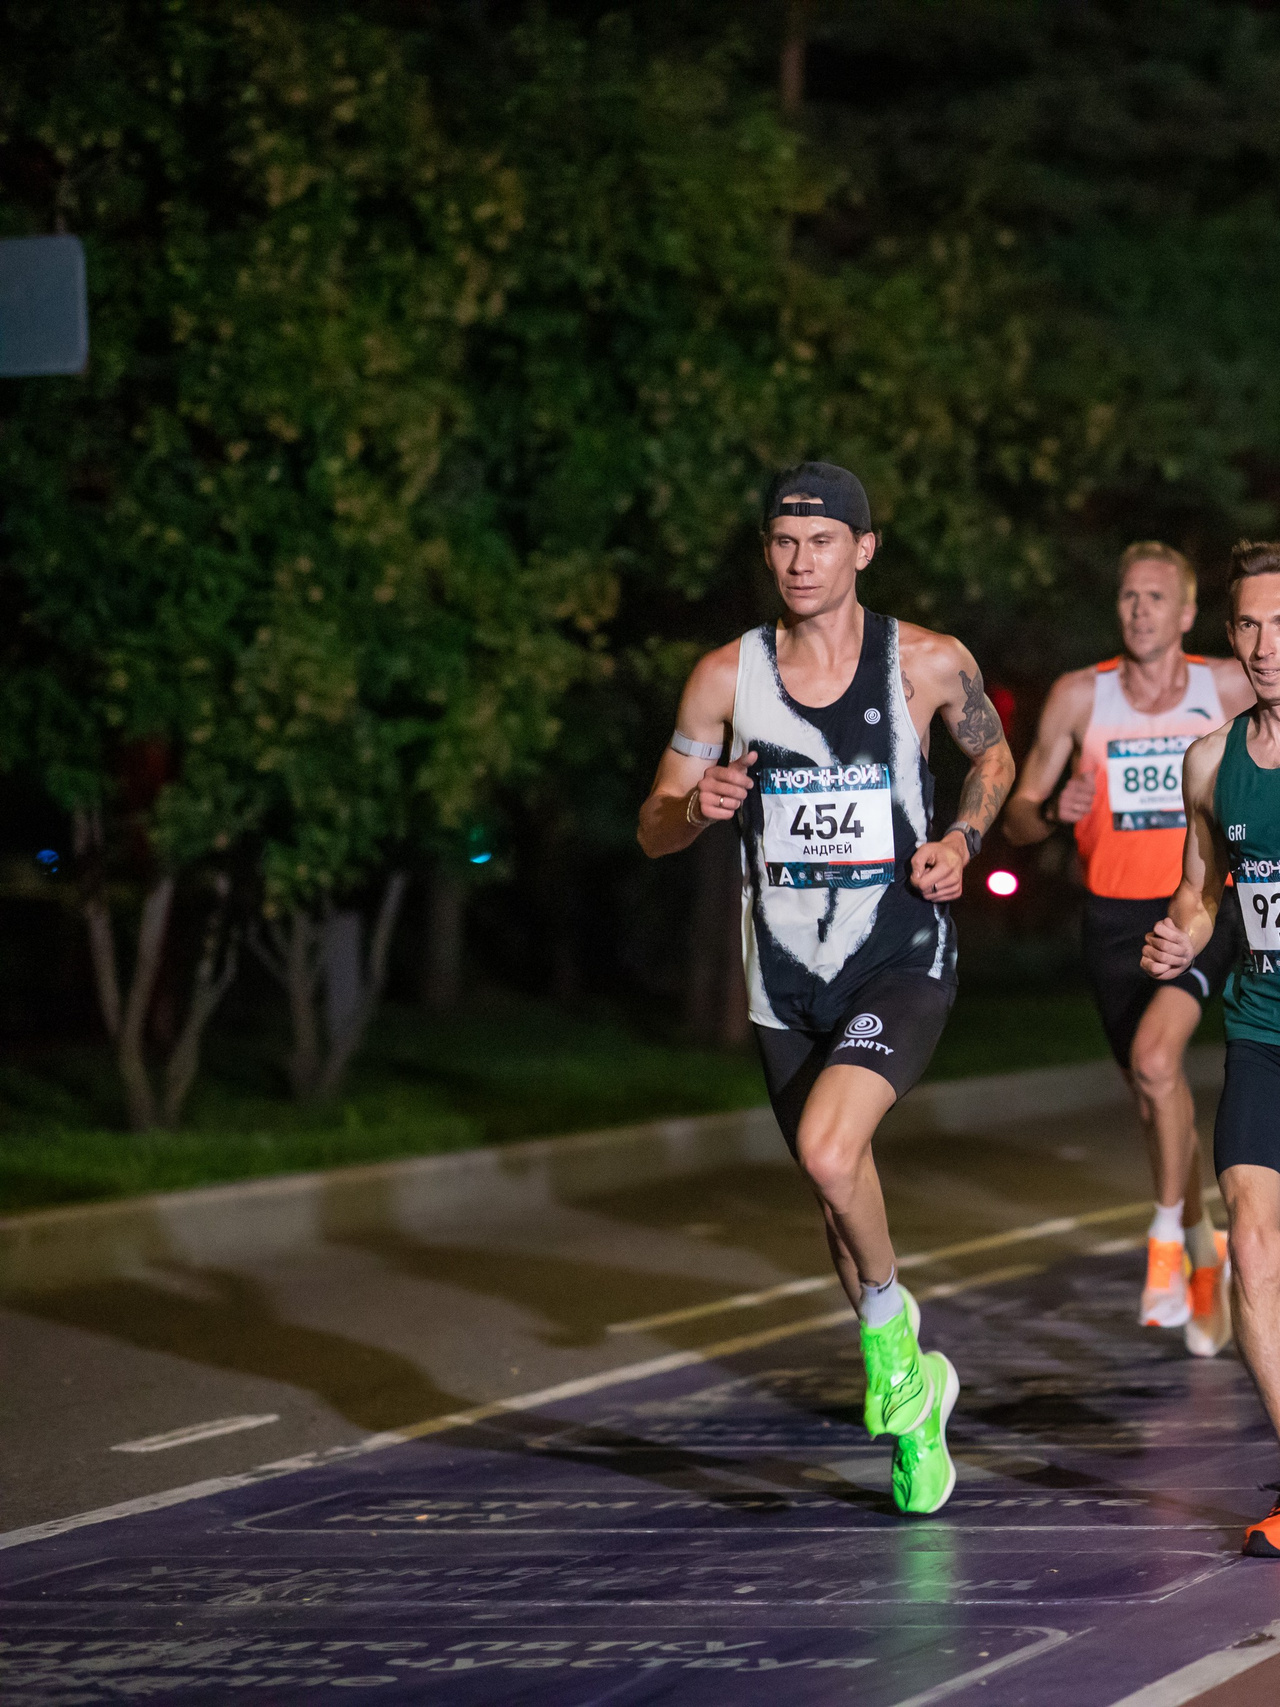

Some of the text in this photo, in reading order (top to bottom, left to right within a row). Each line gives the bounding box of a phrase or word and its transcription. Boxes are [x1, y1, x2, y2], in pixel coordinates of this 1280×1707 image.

[1123, 764, 1184, 792] 886
[789, 802, 864, 840] 454
[803, 843, 853, 856] АНДРЕЙ
[445, 1640, 769, 1654] пятку
[385, 1658, 879, 1672] чувствуя
